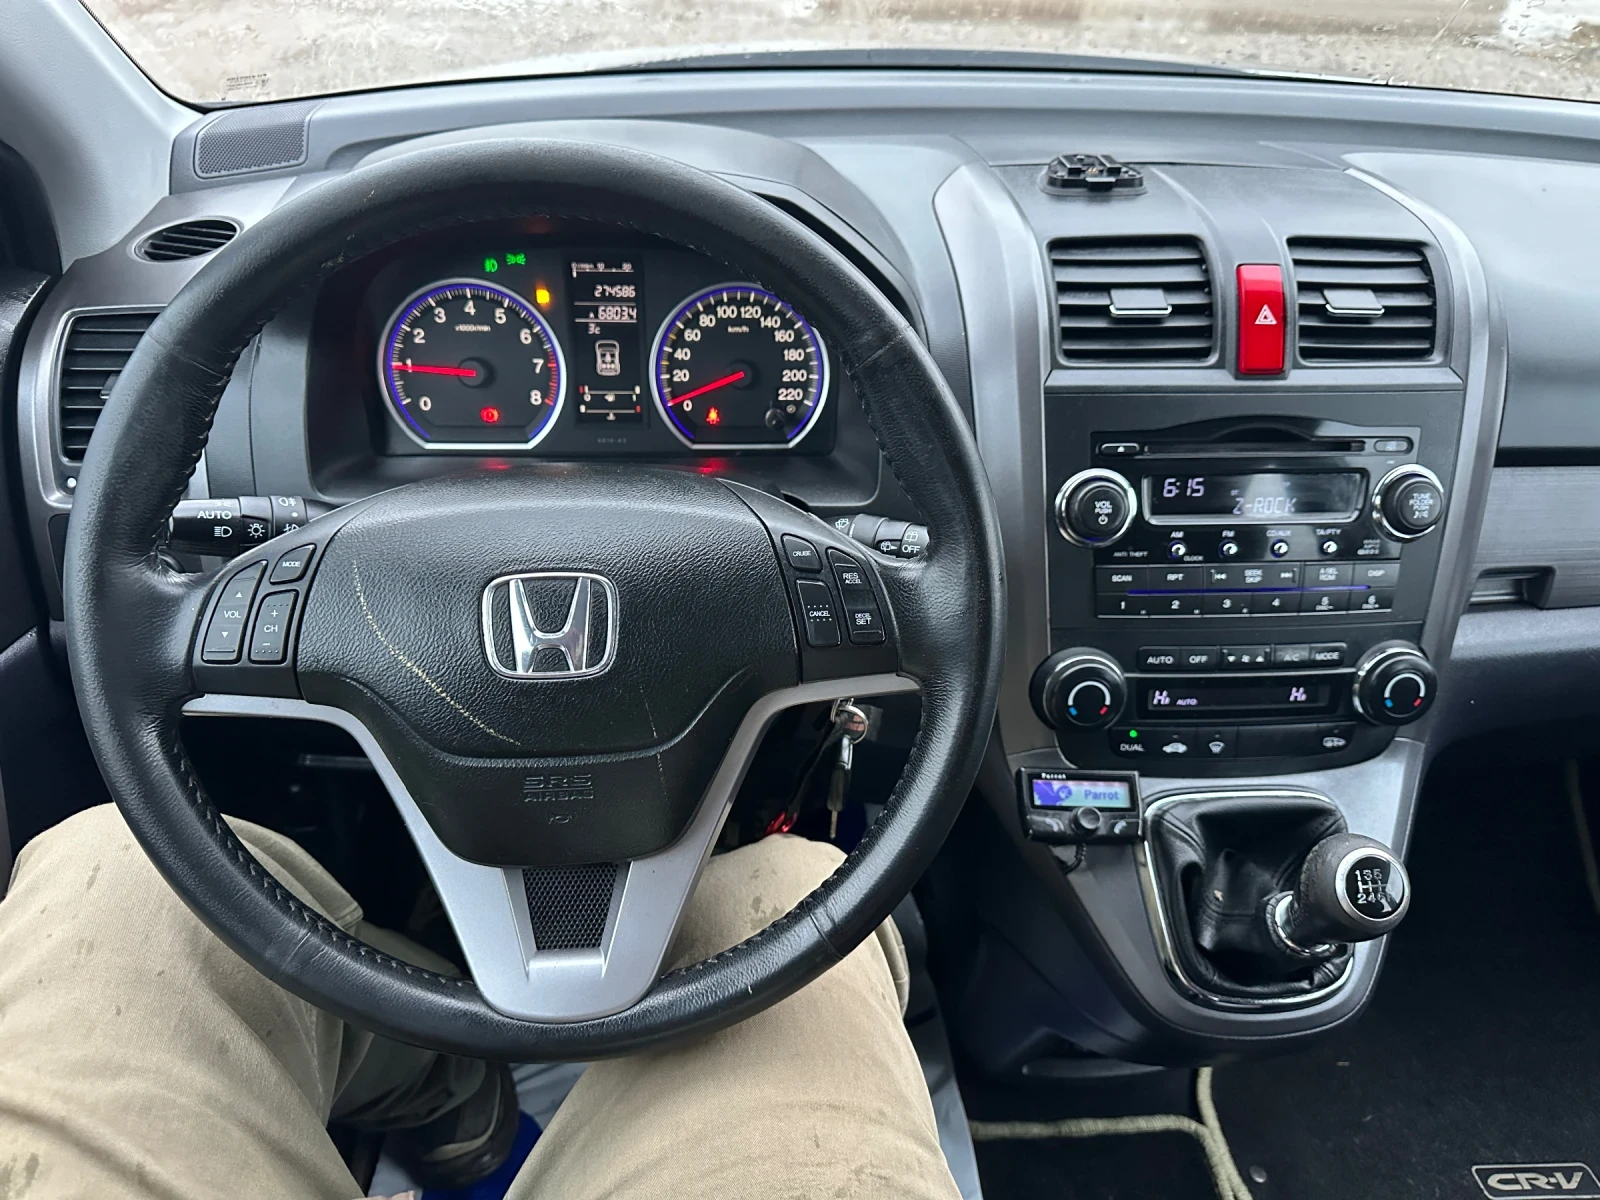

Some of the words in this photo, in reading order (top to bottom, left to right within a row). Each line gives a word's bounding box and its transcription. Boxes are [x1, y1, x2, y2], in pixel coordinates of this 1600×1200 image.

[594, 285, 636, 298] 274586
[464, 301, 476, 316] 4
[716, 305, 737, 319] 100
[740, 305, 761, 319] 120
[433, 308, 447, 323] 3
[494, 308, 507, 324] 5
[699, 314, 716, 327] 80
[760, 316, 781, 329] 140
[413, 329, 426, 344] 2
[519, 329, 533, 344] 6
[684, 329, 701, 342] 60
[774, 330, 795, 343] 160
[674, 348, 691, 361] 40
[783, 349, 805, 361] 180
[532, 359, 545, 374] 7
[673, 369, 690, 382] 20
[782, 369, 807, 382] 200
[530, 390, 543, 405] 8
[778, 388, 803, 401] 220
[419, 396, 432, 411] 0
[683, 400, 692, 412] 0
[1163, 478, 1205, 498] 6:15
[1094, 500, 1113, 508] VOL
[1232, 496, 1297, 515] Z-ROCK
[197, 510, 232, 520] AUTO
[902, 545, 920, 553] OFF
[1111, 574, 1133, 582] SCAN
[1166, 573, 1184, 581] RPT
[1120, 601, 1125, 610] 1
[1171, 600, 1180, 609] 2
[1222, 599, 1231, 608] 3
[1271, 598, 1280, 607] 4
[1146, 656, 1174, 664] AUTO
[1315, 652, 1340, 660] MODE
[1084, 789, 1119, 800] Parrot
[1487, 1171, 1583, 1190] CR-V
